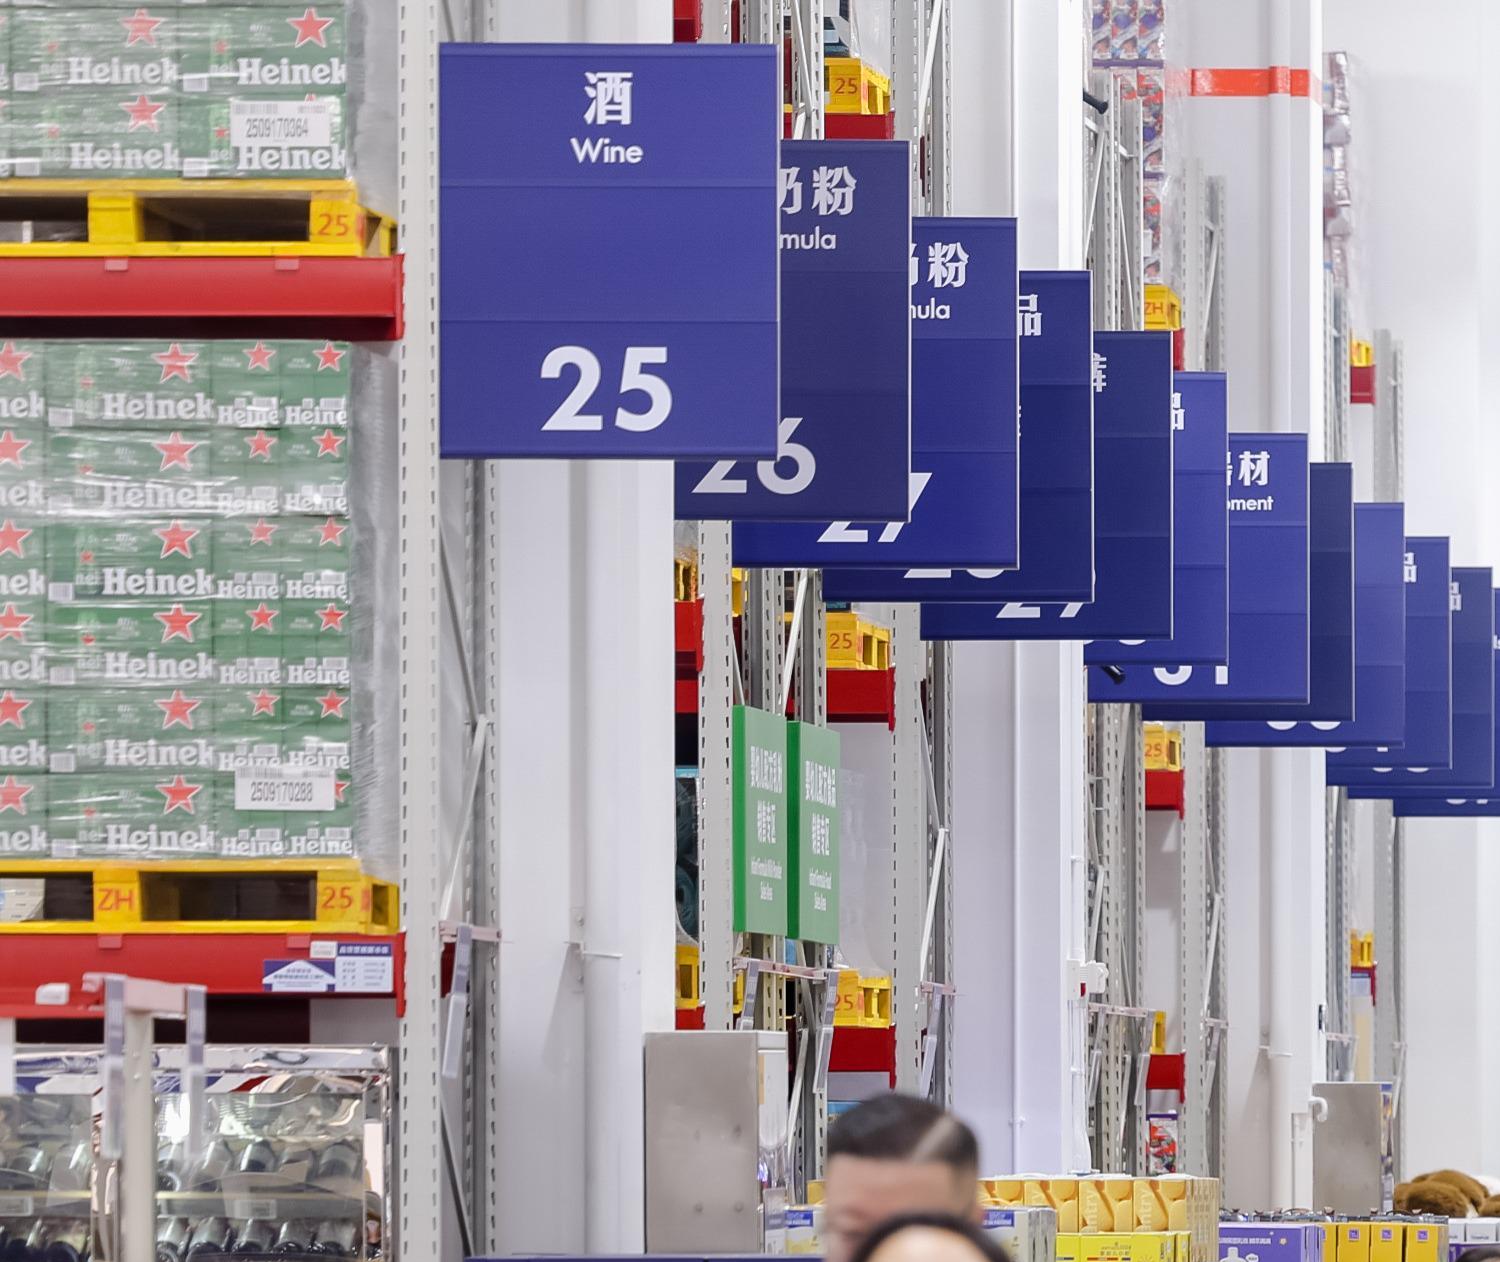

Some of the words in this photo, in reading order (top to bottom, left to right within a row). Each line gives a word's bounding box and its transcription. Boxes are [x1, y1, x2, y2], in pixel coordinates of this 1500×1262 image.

[834, 77, 858, 94] 25
[584, 71, 633, 126] 酒
[571, 138, 643, 165] Wine
[317, 214, 348, 236] 25
[541, 346, 672, 431] 25
[817, 473, 932, 542] 7
[830, 633, 853, 649] 25
[98, 889, 135, 910] ZH
[321, 887, 353, 909] 25
